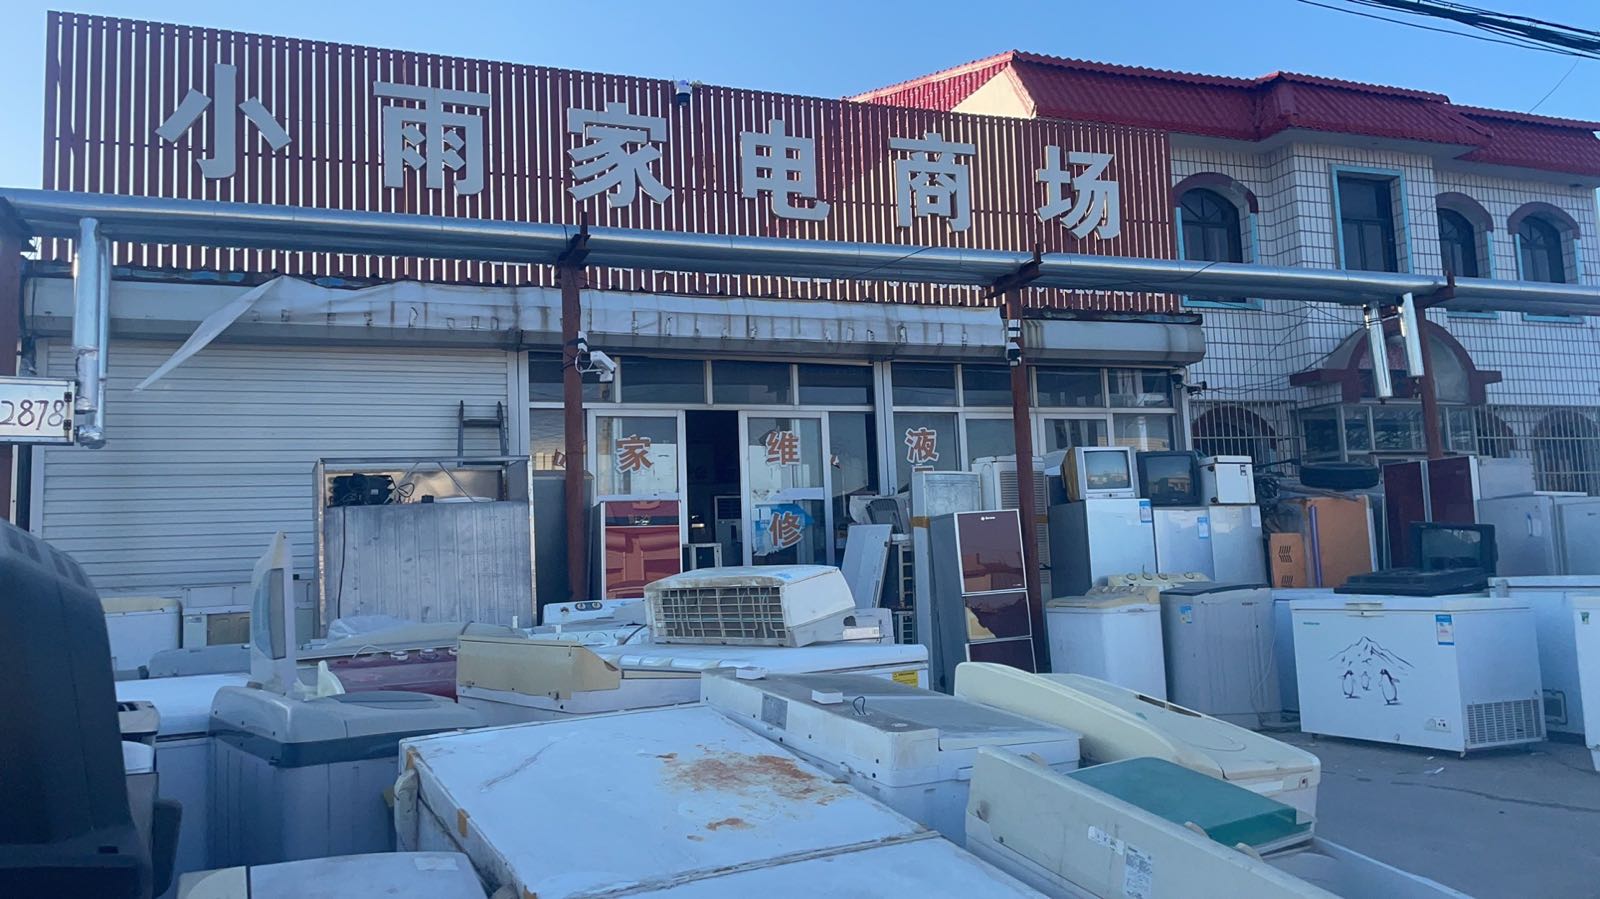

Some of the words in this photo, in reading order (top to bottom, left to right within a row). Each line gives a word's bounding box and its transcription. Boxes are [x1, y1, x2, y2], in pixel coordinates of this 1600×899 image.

[155, 63, 1122, 240] 小雨家电商场
[904, 427, 939, 472] 液
